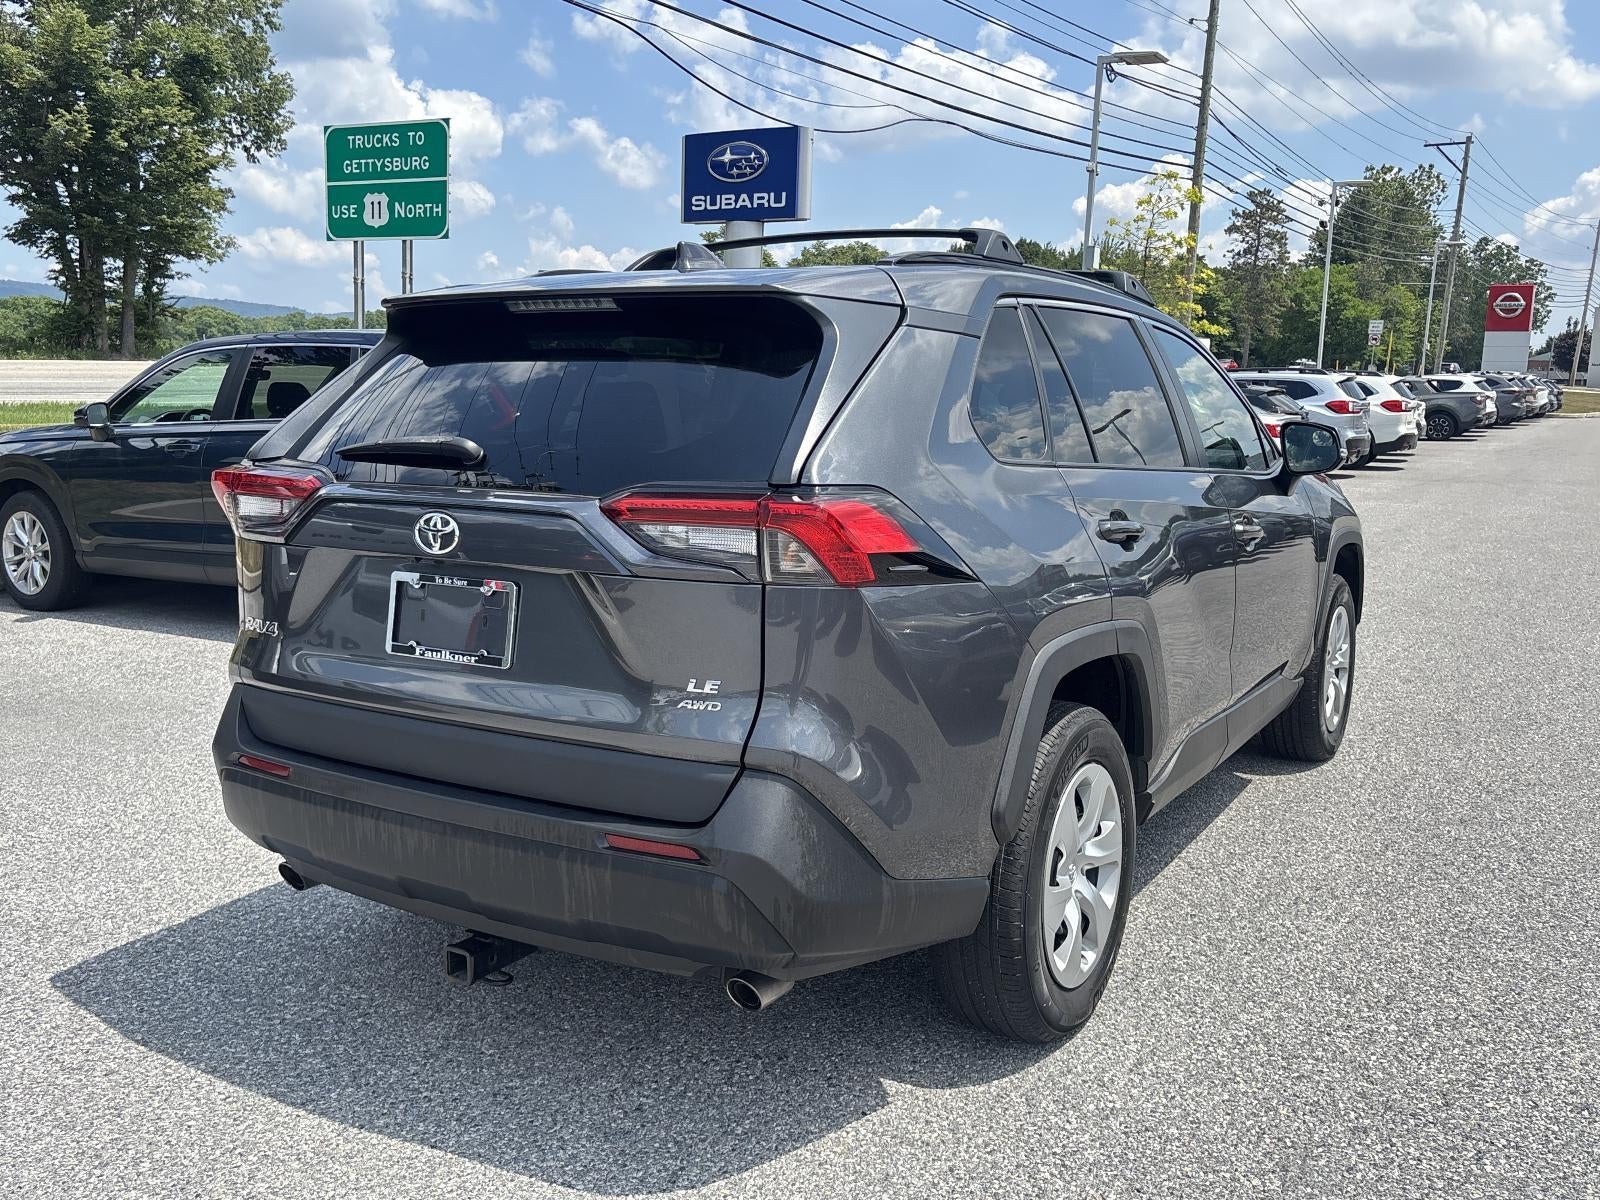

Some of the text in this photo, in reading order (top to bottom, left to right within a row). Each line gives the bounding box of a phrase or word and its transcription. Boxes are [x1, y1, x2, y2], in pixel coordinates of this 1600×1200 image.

[347, 131, 425, 149] TRUCKS TO
[343, 156, 430, 174] GETTYSBURG
[332, 200, 442, 220] USE 11 NORTH
[691, 191, 787, 211] SUBARU
[435, 576, 468, 586] To Be Sure
[245, 616, 279, 637] RAV4
[415, 647, 479, 663] Faulkner
[686, 678, 722, 694] LE
[676, 699, 722, 712] AWD
